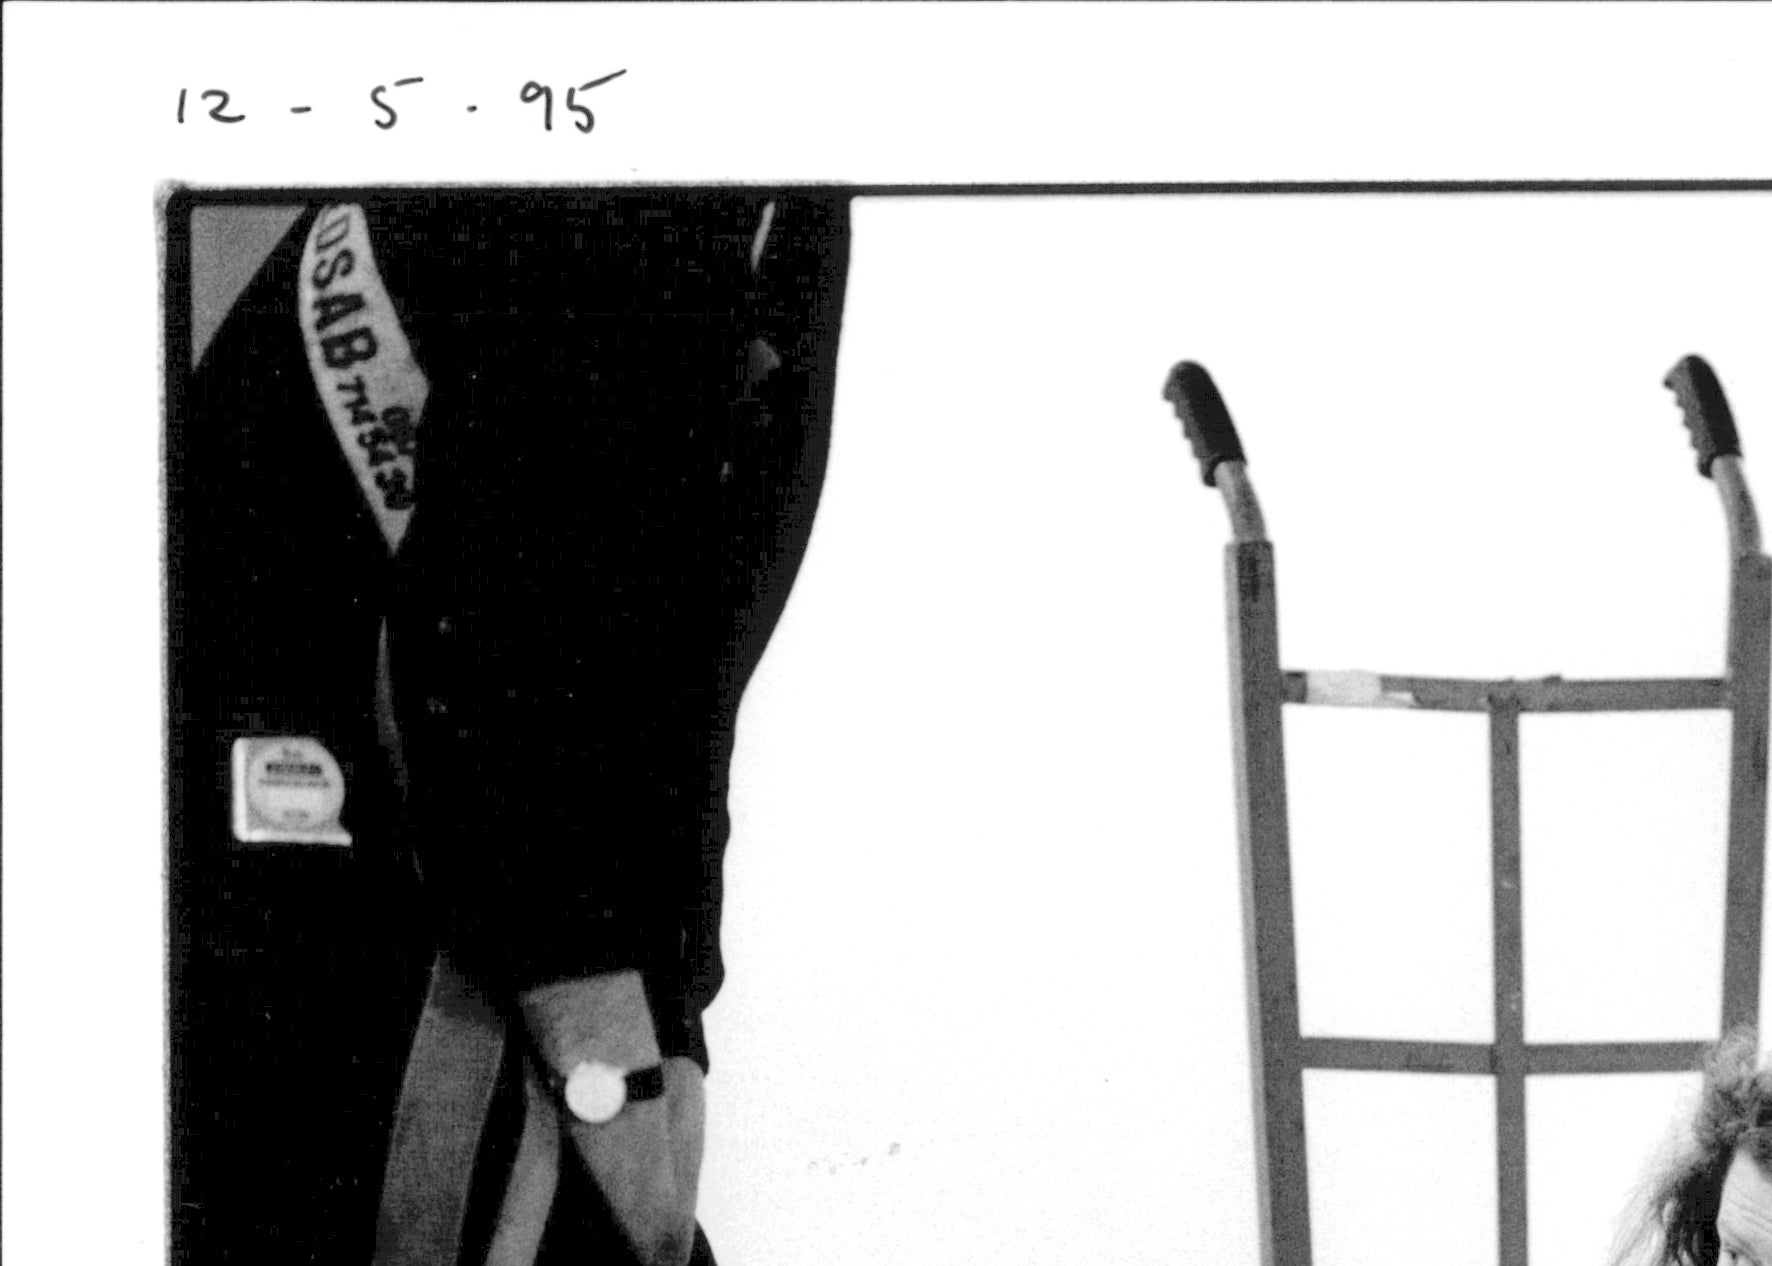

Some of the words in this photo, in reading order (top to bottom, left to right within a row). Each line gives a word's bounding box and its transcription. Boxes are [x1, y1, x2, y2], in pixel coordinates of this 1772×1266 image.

[177, 88, 246, 124] 12
[370, 76, 424, 130] 5
[519, 69, 627, 134] 95
